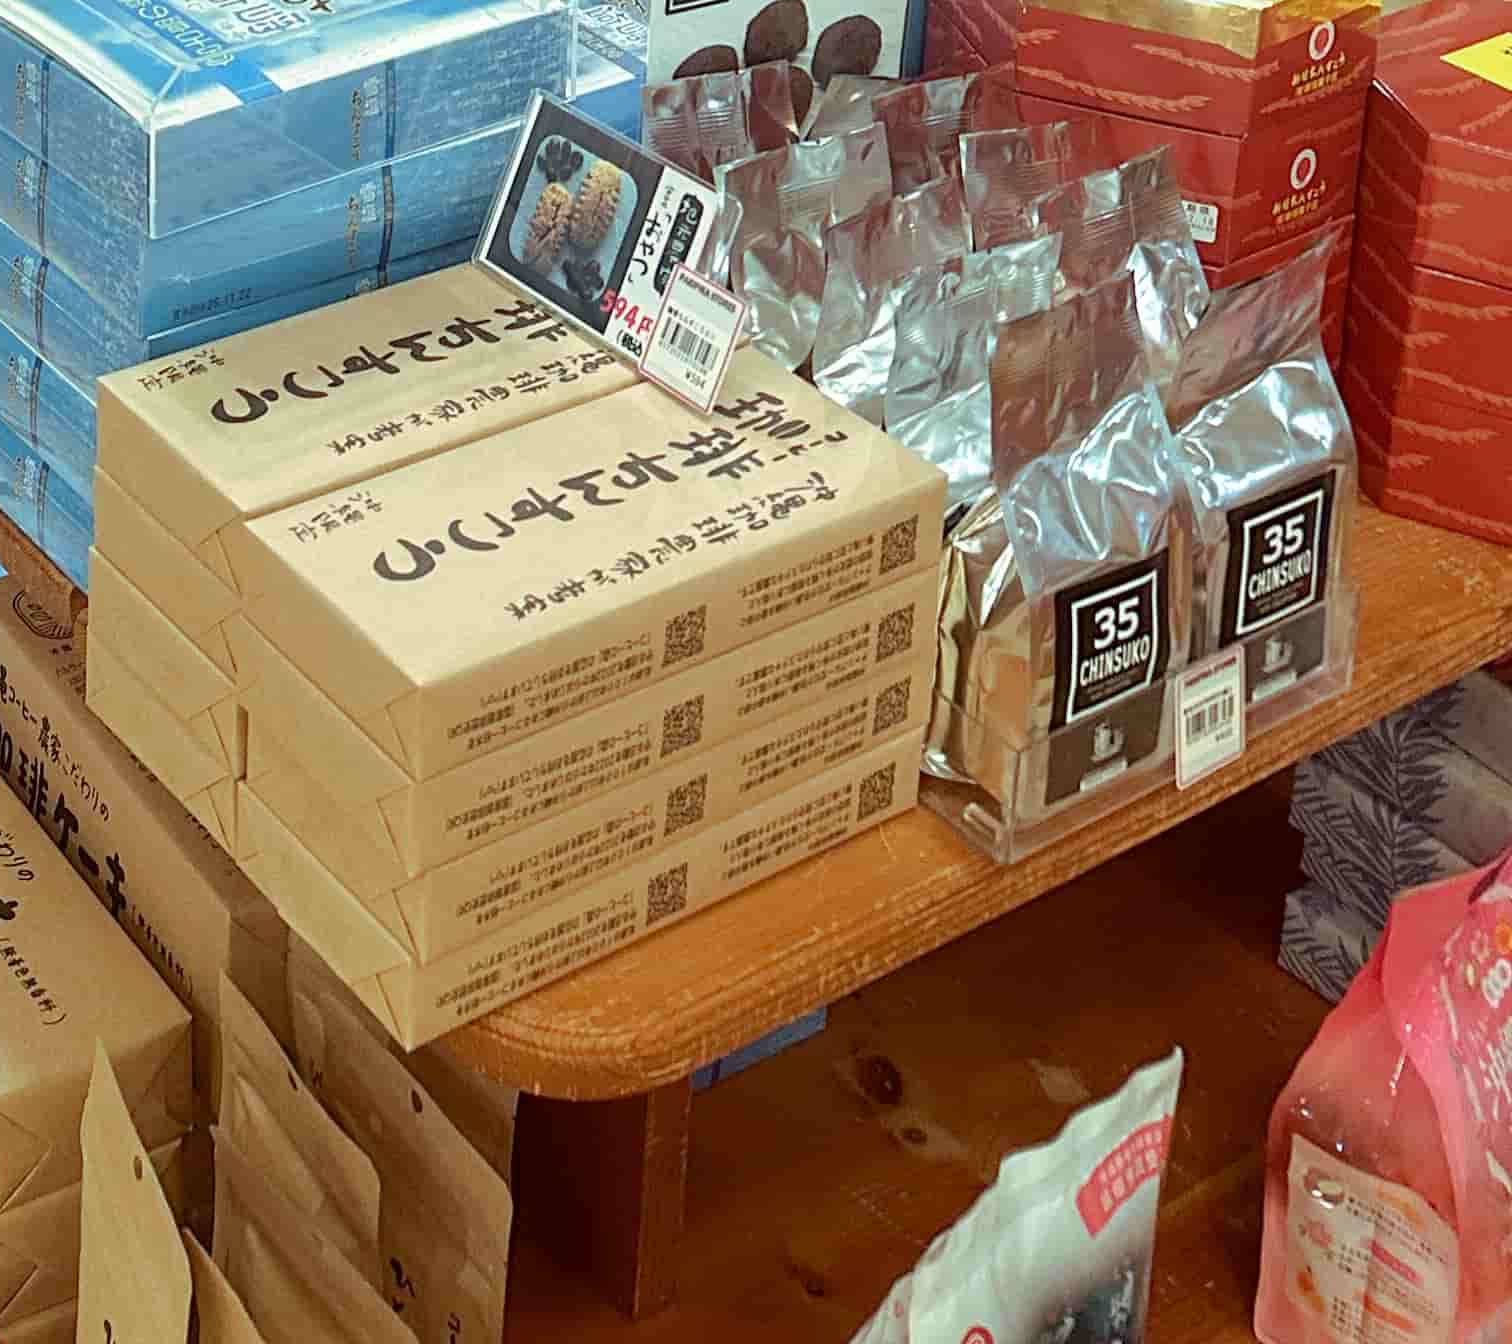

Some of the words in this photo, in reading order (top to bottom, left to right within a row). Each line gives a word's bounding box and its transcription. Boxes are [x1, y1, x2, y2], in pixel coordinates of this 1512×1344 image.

[373, 387, 810, 583] 珈琲ちんすこう
[1263, 513, 1305, 565] 35
[1247, 548, 1312, 600] CHINSUKO
[1094, 597, 1141, 649] 35
[1079, 635, 1151, 688] CHINSUKO
